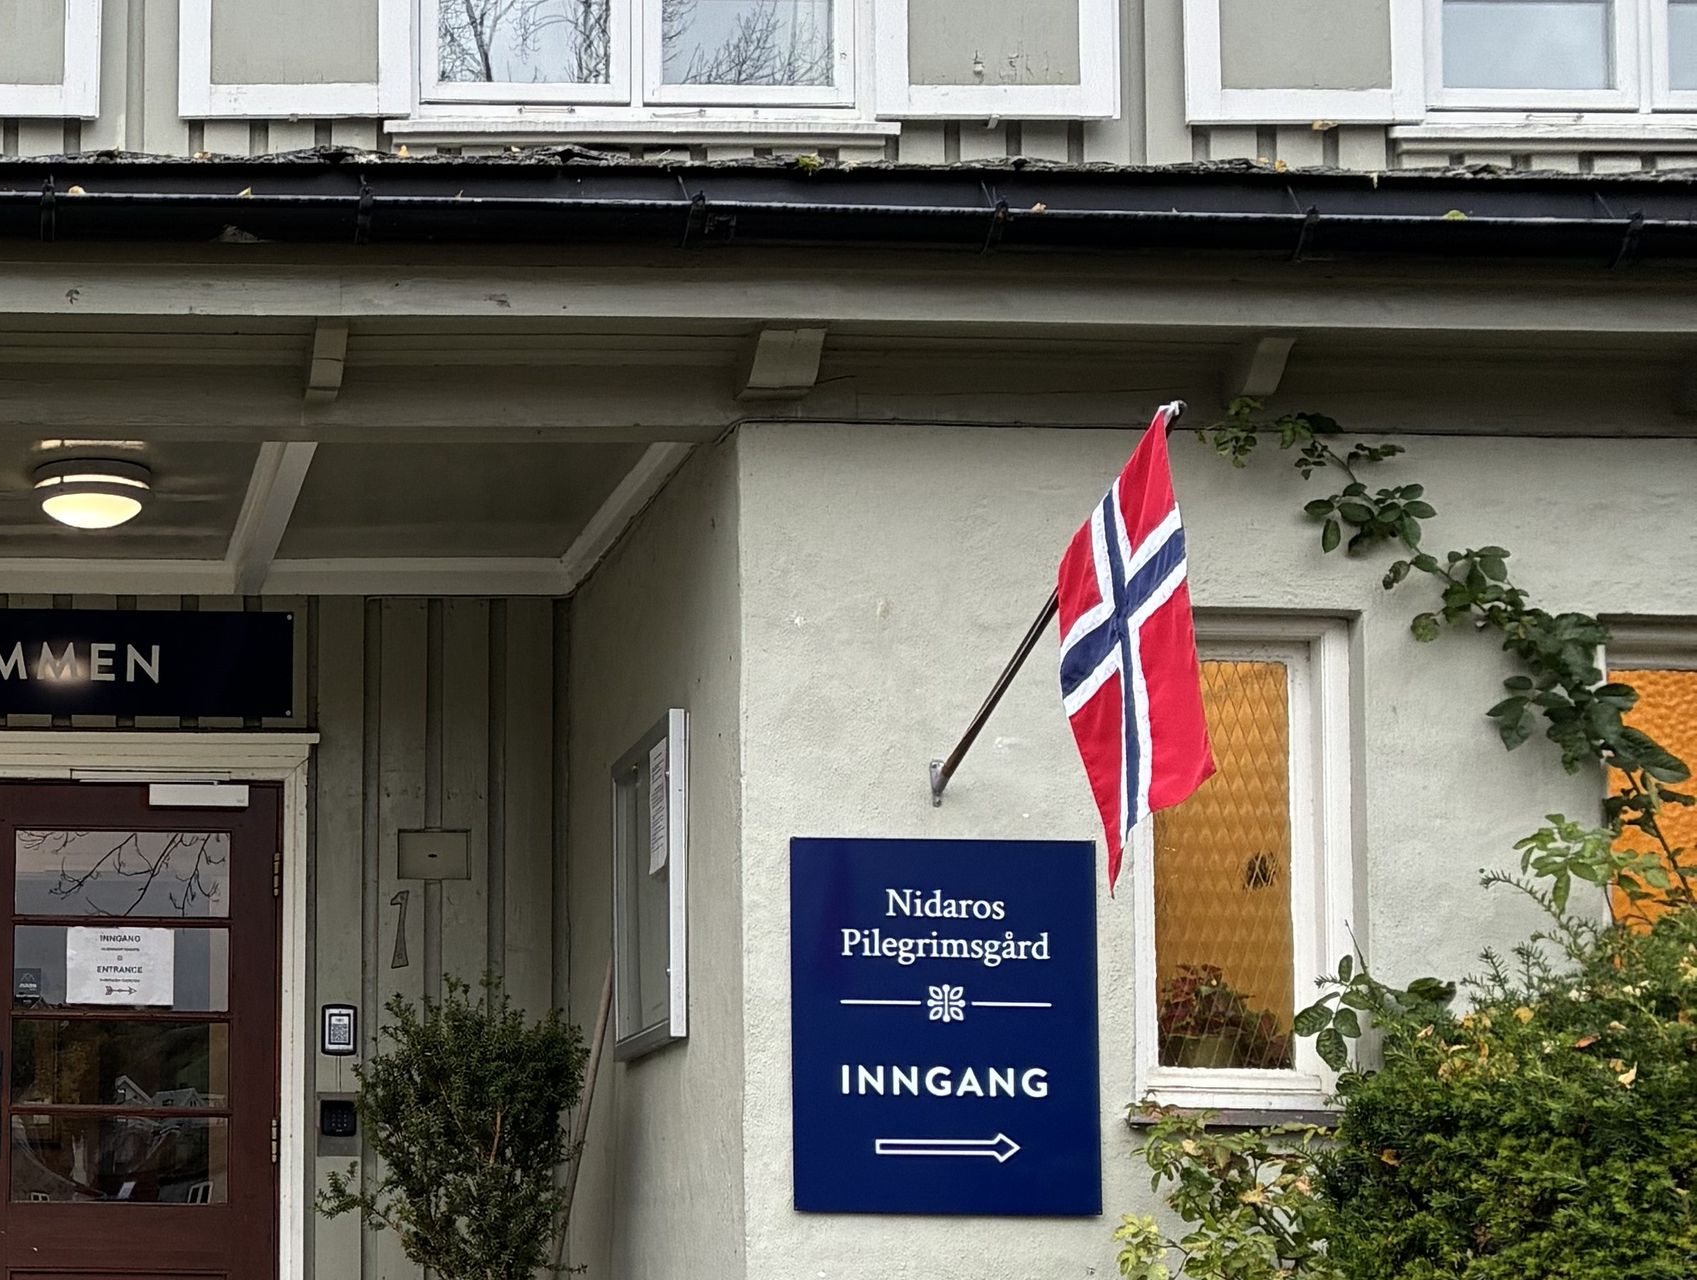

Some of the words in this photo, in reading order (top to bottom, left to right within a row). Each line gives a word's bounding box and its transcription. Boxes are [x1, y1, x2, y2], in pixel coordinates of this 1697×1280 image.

[885, 888, 1006, 921] Nidaros
[840, 928, 1051, 967] Pilegrimsgård
[96, 965, 144, 974] ENTRANCE
[841, 1063, 1049, 1099] INNGANG
